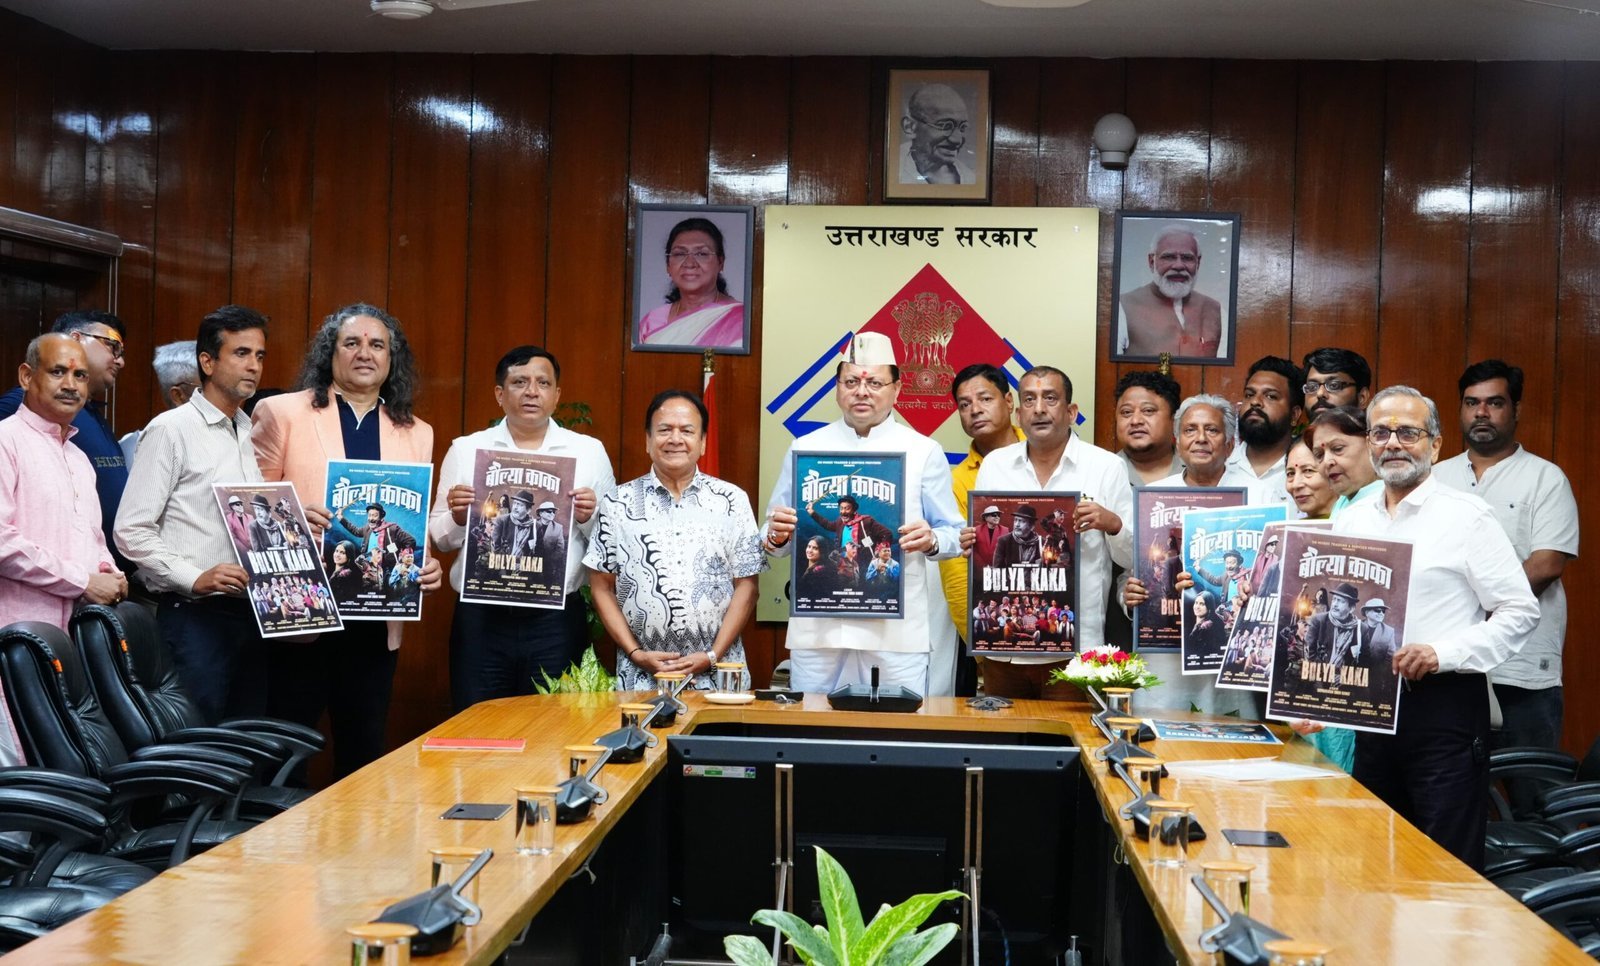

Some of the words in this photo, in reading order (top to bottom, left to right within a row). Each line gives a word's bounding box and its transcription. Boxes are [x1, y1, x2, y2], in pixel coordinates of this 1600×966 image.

[825, 226, 944, 252] उत्तराखण्ड
[956, 227, 1038, 253] सरकार
[897, 399, 927, 409] सत्यमेव
[932, 400, 955, 410] जयते
[525, 468, 561, 495] काका
[850, 475, 897, 505] काका
[380, 484, 422, 514] काका
[247, 550, 286, 575] BOLYA
[283, 548, 316, 572] KAKA
[488, 553, 516, 570] BOLYA
[519, 556, 543, 573] KAKA
[1299, 546, 1346, 579] बौल्या
[1348, 556, 1393, 590] काका
[983, 566, 1026, 592] BOLYA
[1030, 567, 1067, 592] KAKA
[1301, 660, 1336, 683] BOLYA
[1340, 665, 1369, 687] KAKA
